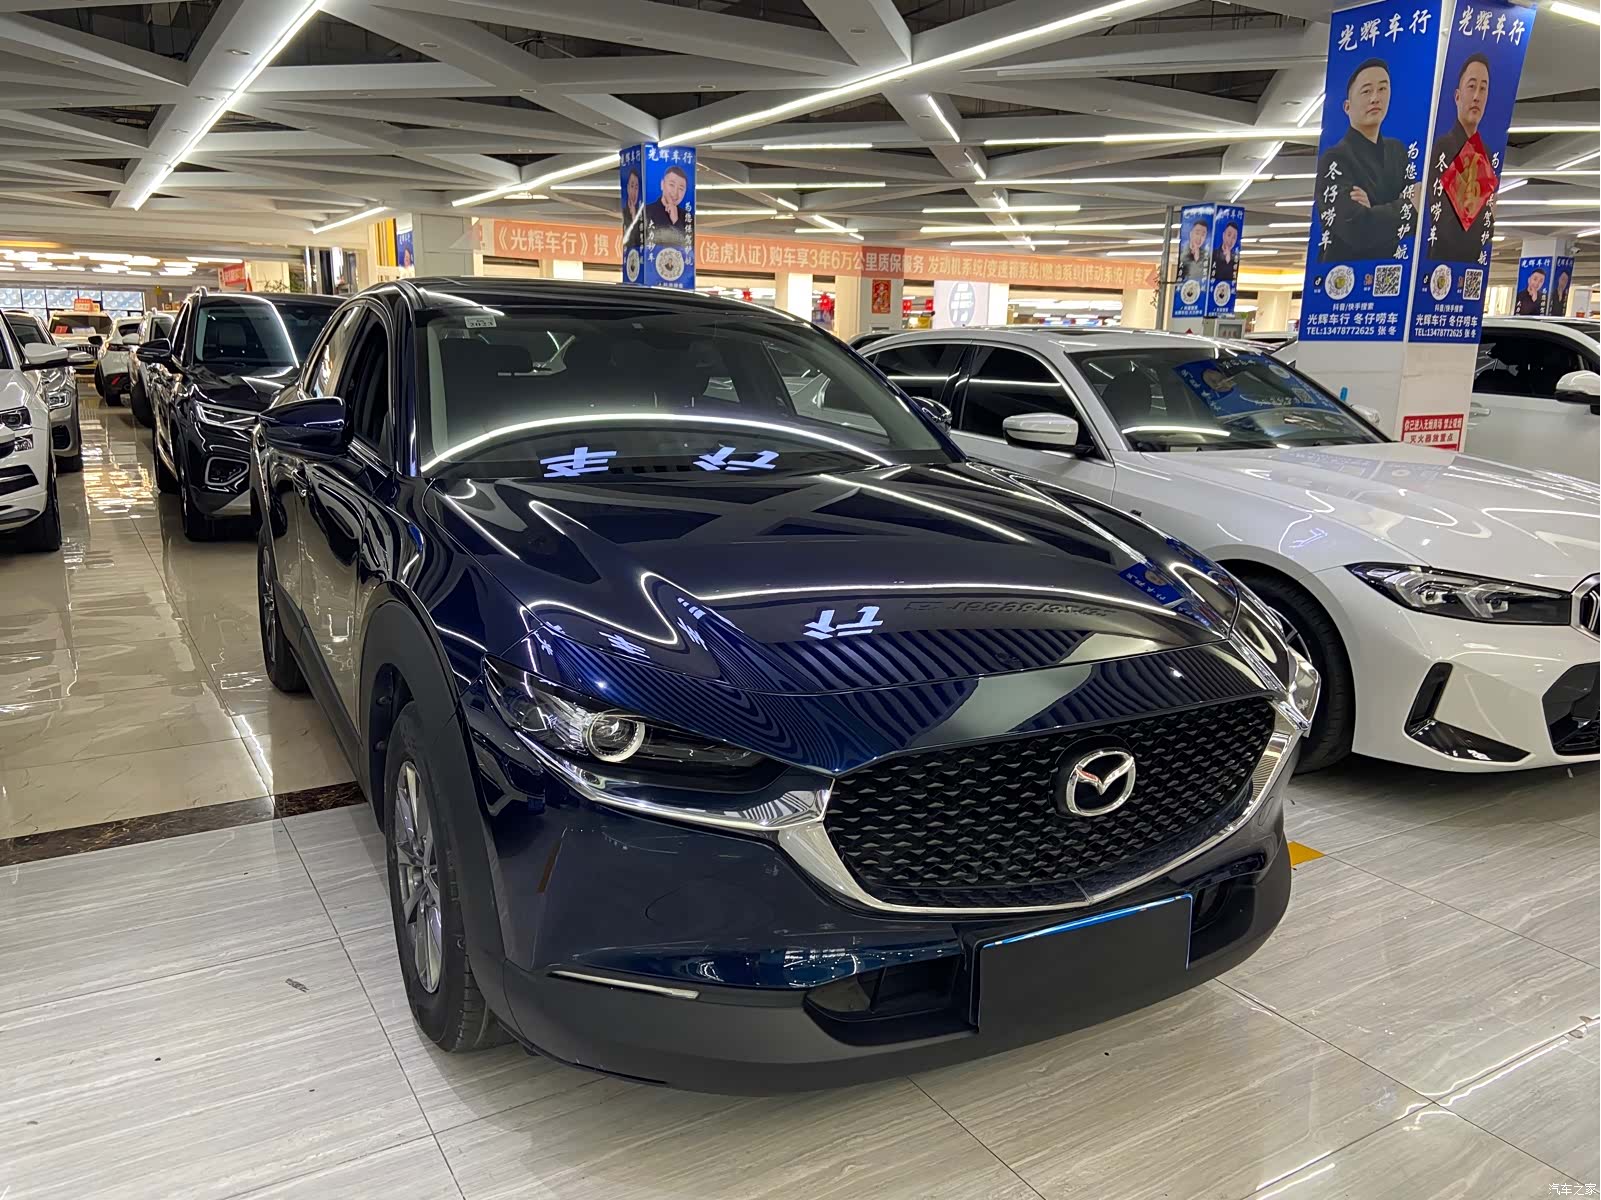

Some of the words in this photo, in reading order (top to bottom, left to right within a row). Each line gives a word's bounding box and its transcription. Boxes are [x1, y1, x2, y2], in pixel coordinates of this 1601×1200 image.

[1338, 9, 1432, 51] 光辉车行
[1458, 5, 1526, 46] 光辉车行
[647, 149, 694, 165] 光辉车行
[1318, 161, 1343, 252] 冬仔唠车
[1392, 140, 1419, 260] 为您保驾护航
[1477, 151, 1500, 266] 为保驾护航
[1307, 313, 1351, 325] 光辉车行
[1353, 312, 1399, 325] 冬仔唠车
[1332, 302, 1375, 311] 抖音/快手搜索
[1415, 314, 1448, 327] 光辉车行
[1306, 326, 1375, 336] TEL:13478772625
